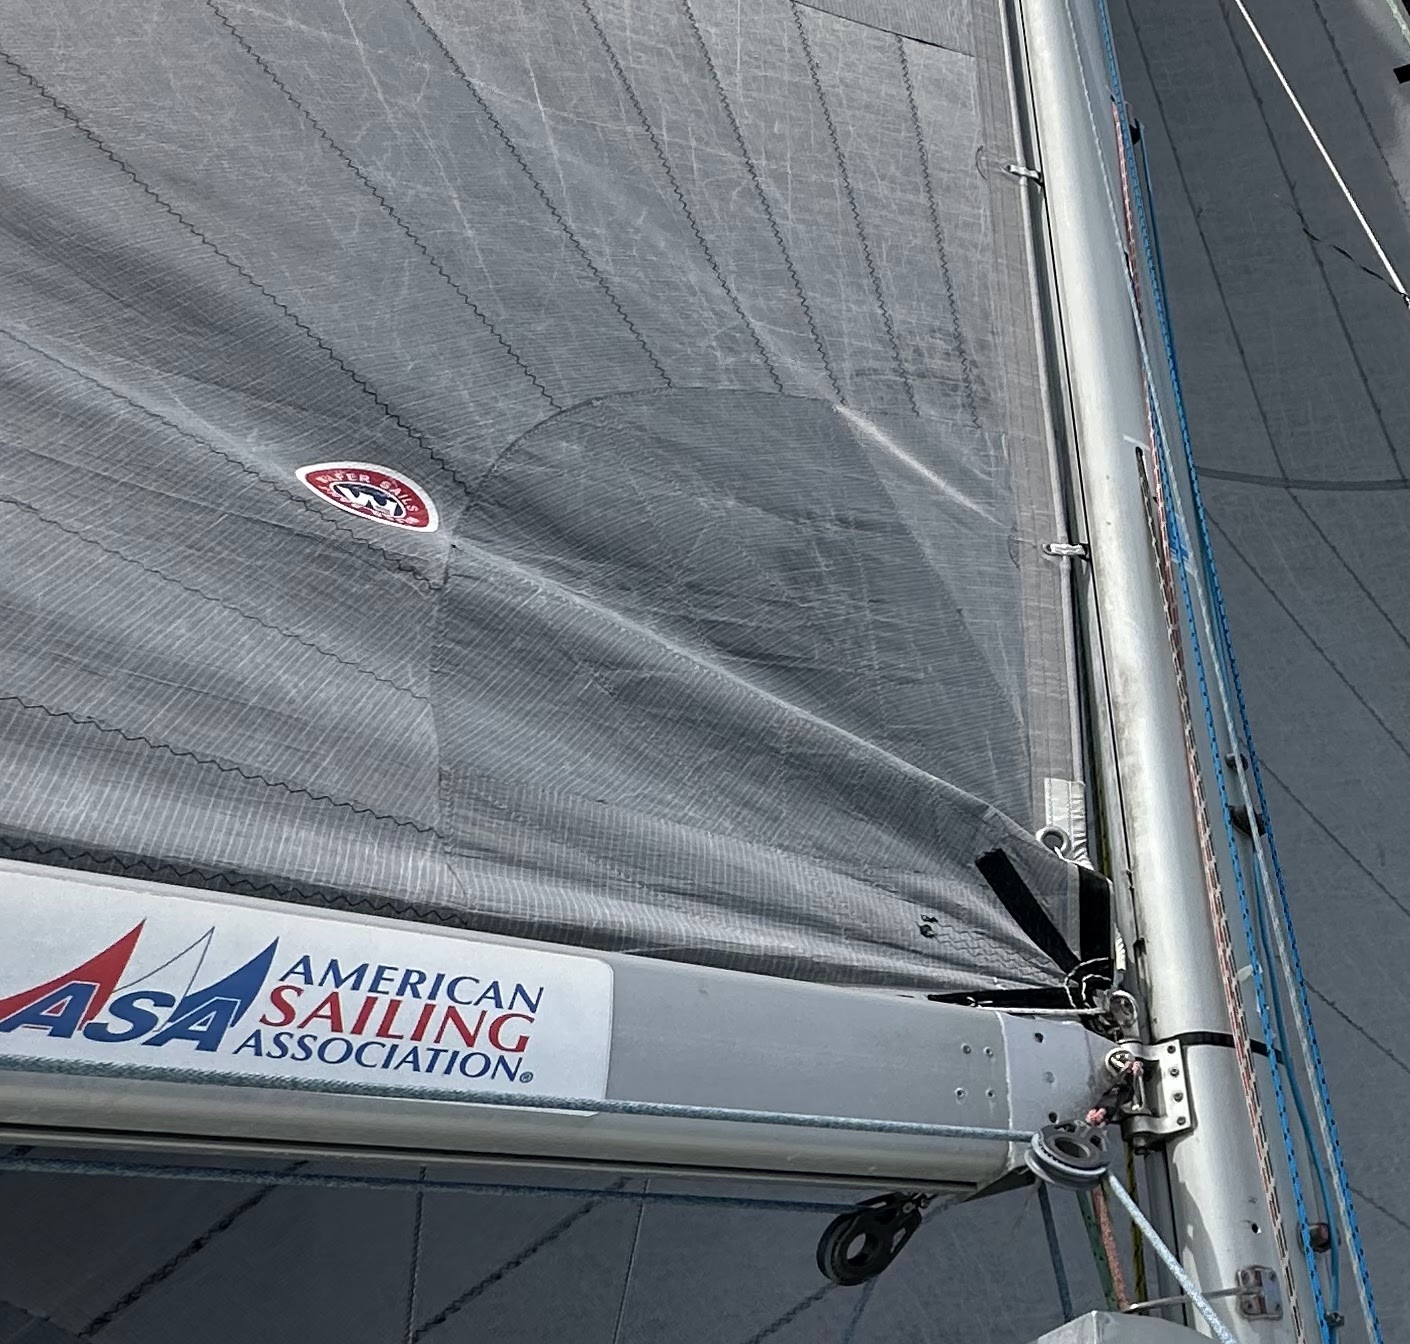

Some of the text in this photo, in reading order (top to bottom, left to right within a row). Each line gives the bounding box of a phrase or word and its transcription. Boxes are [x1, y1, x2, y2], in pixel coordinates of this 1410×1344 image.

[379, 480, 419, 513] SAILS
[277, 954, 544, 1014] AMERICAN
[0, 981, 240, 1053] ASA
[259, 984, 535, 1053] SAILING
[232, 1028, 524, 1083] ASSOCIATION
